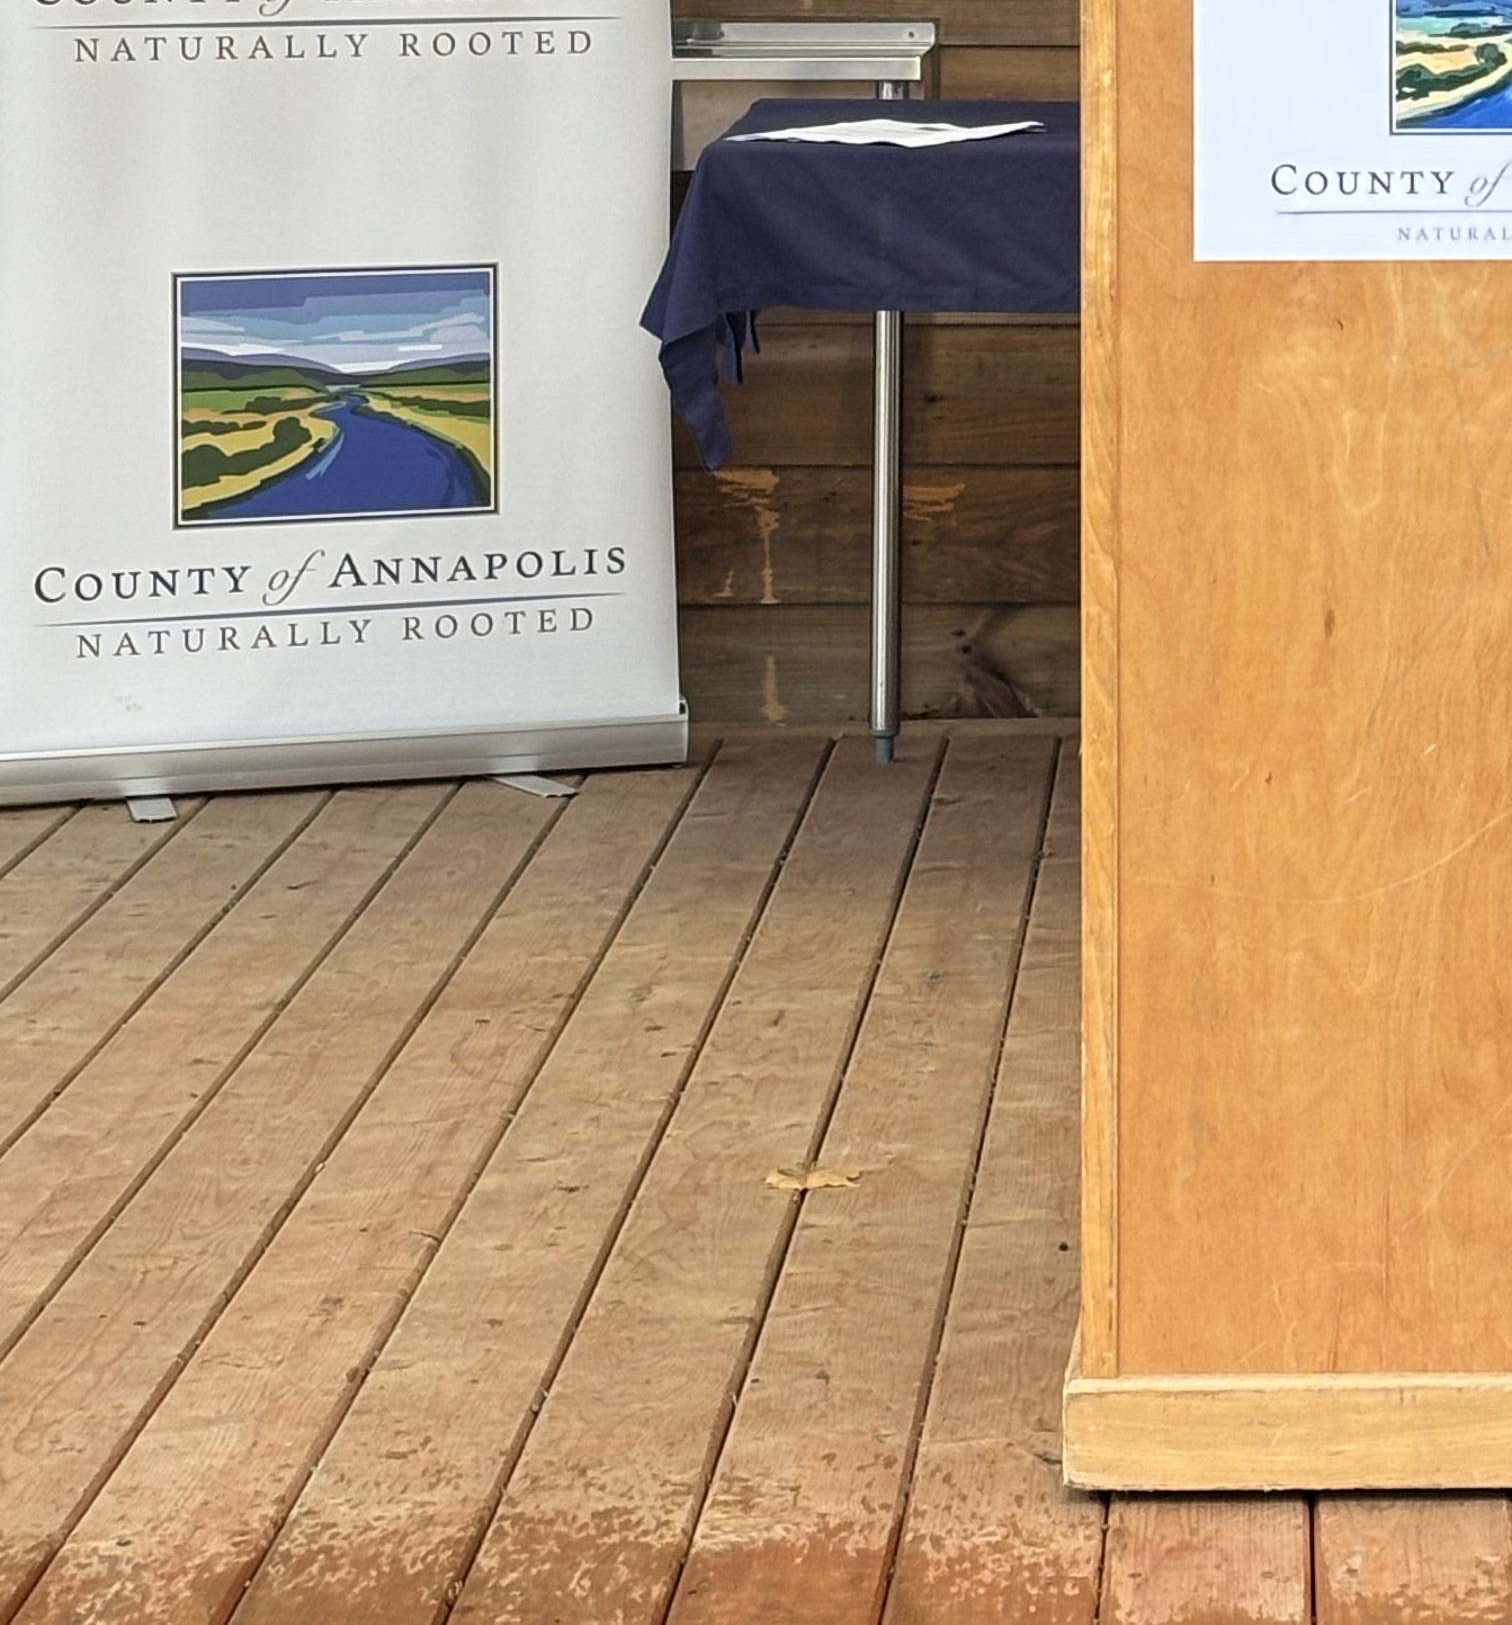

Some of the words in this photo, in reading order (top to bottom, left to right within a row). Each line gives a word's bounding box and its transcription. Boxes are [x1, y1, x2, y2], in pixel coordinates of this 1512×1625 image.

[74, 34, 368, 62] NATURALLY
[399, 31, 591, 56] ROOTED
[1271, 164, 1454, 195] COUNTY
[35, 566, 251, 603] COUNTY
[262, 550, 325, 606] of
[328, 547, 625, 588] ANNAPOLIS
[76, 619, 371, 658] NATURALLY
[402, 608, 592, 640] ROOTED
